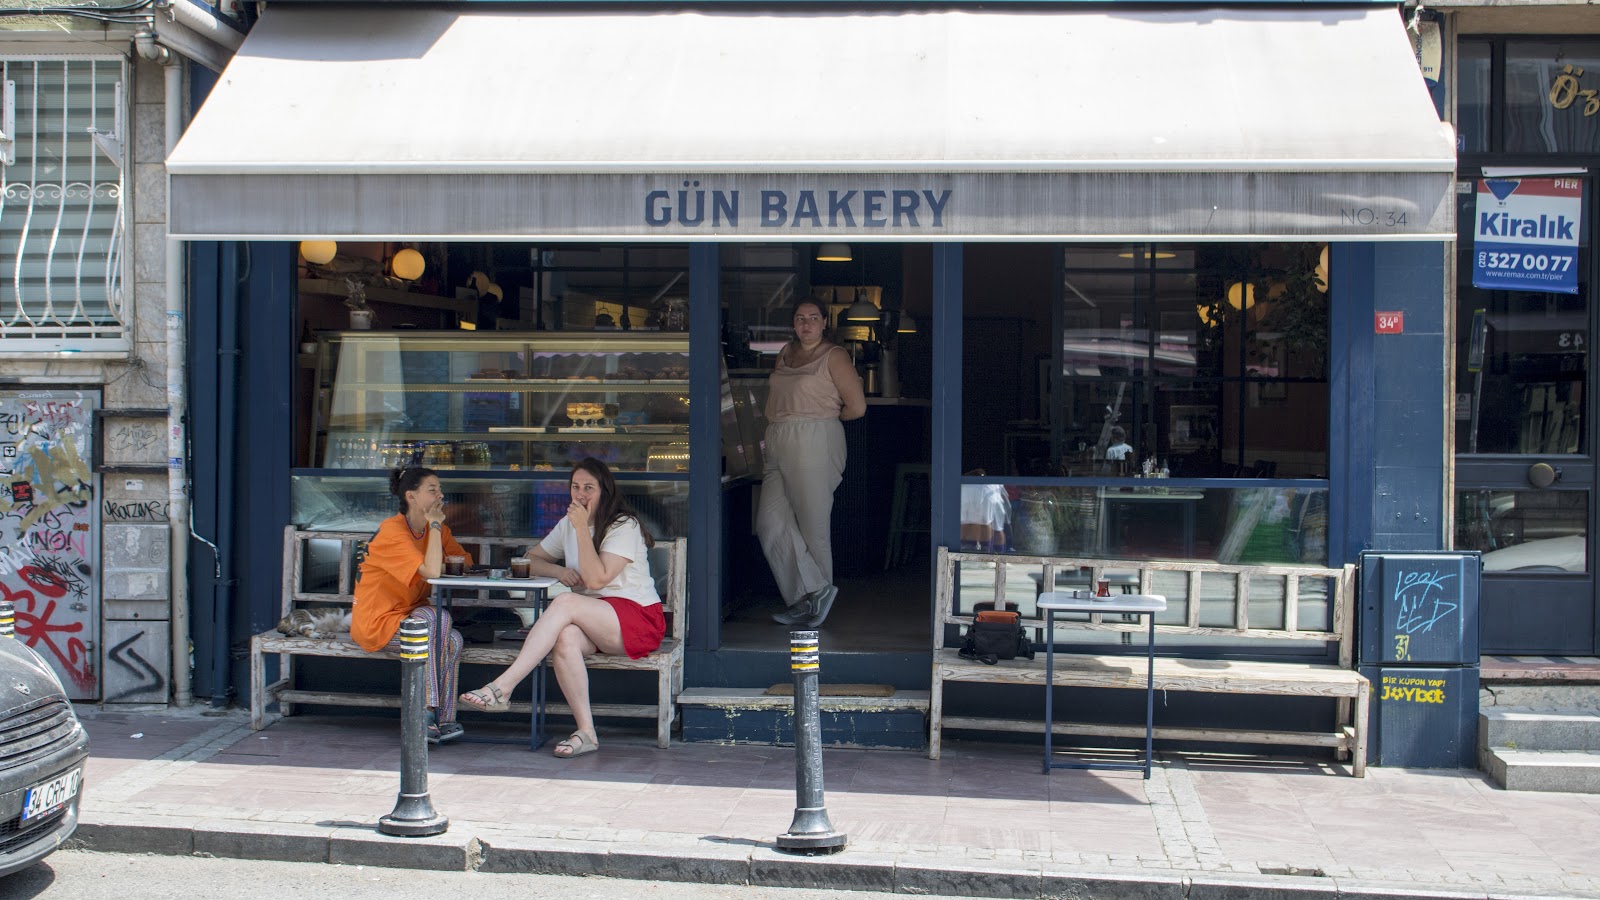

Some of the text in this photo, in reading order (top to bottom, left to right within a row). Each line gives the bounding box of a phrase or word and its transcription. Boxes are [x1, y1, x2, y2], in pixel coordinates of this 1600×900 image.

[645, 180, 952, 227] GÜN BAKERY
[1341, 208, 1408, 227] NO: 34
[1480, 212, 1574, 240] Kiralık
[1486, 270, 1563, 281] www.remax.com.tr/pier
[29, 788, 43, 815] 34
[45, 777, 68, 808] CRH
